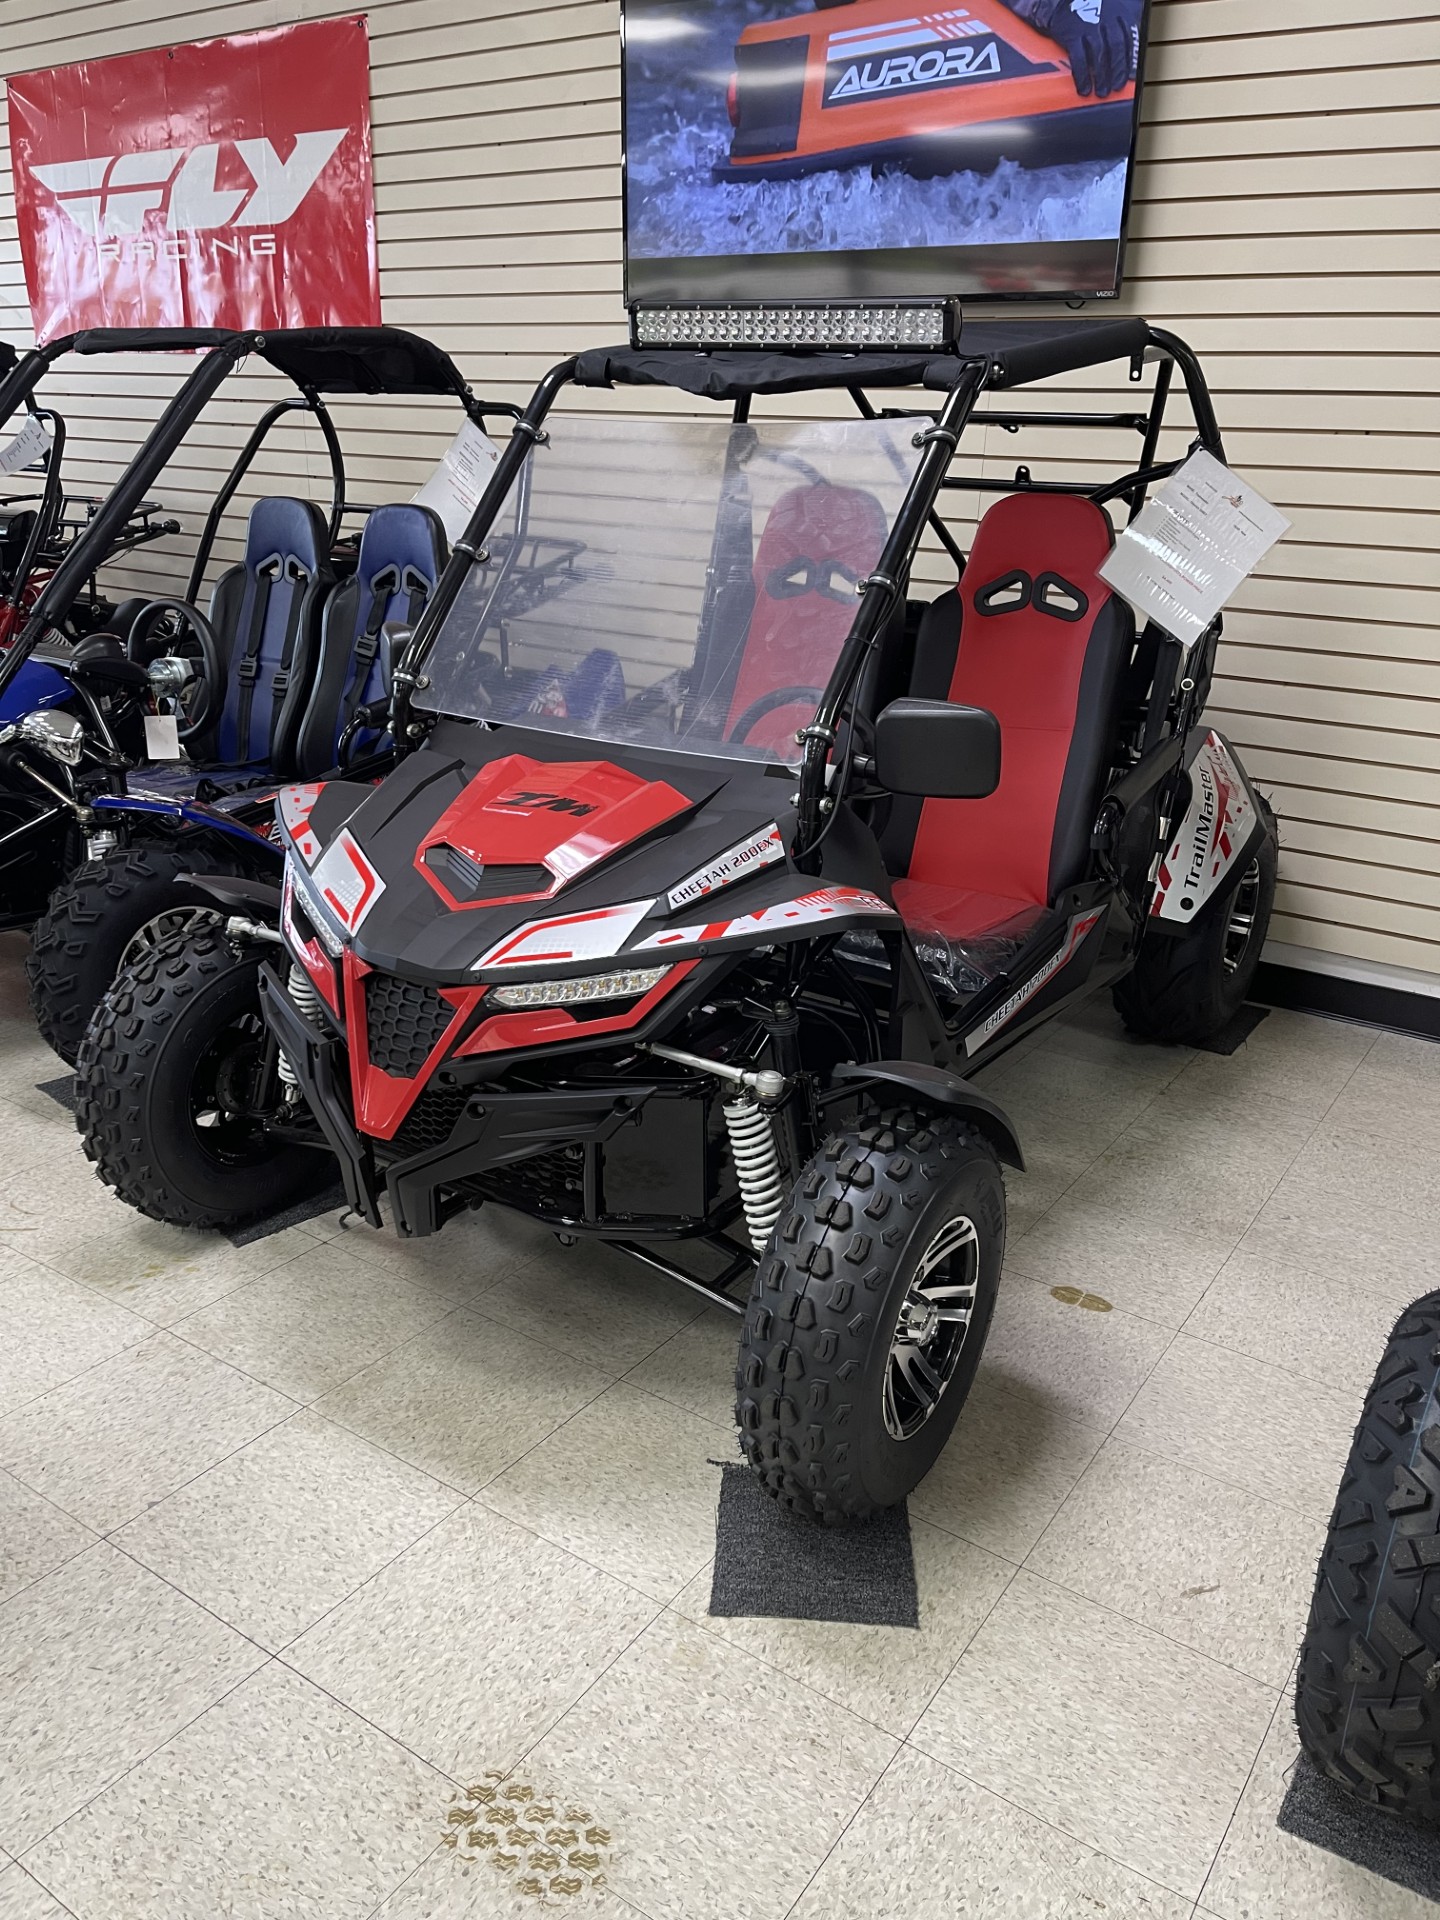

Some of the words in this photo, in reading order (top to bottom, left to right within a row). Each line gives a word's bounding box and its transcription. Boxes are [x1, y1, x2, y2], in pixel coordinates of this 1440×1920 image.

[828, 41, 1001, 100] AURORA
[29, 127, 350, 236] FLY
[100, 233, 277, 262] RACING
[1184, 766, 1214, 889] TrailMaster
[671, 863, 731, 904] CHEETAH
[731, 836, 774, 868] 200EX
[984, 986, 1030, 1033] CHEETAH
